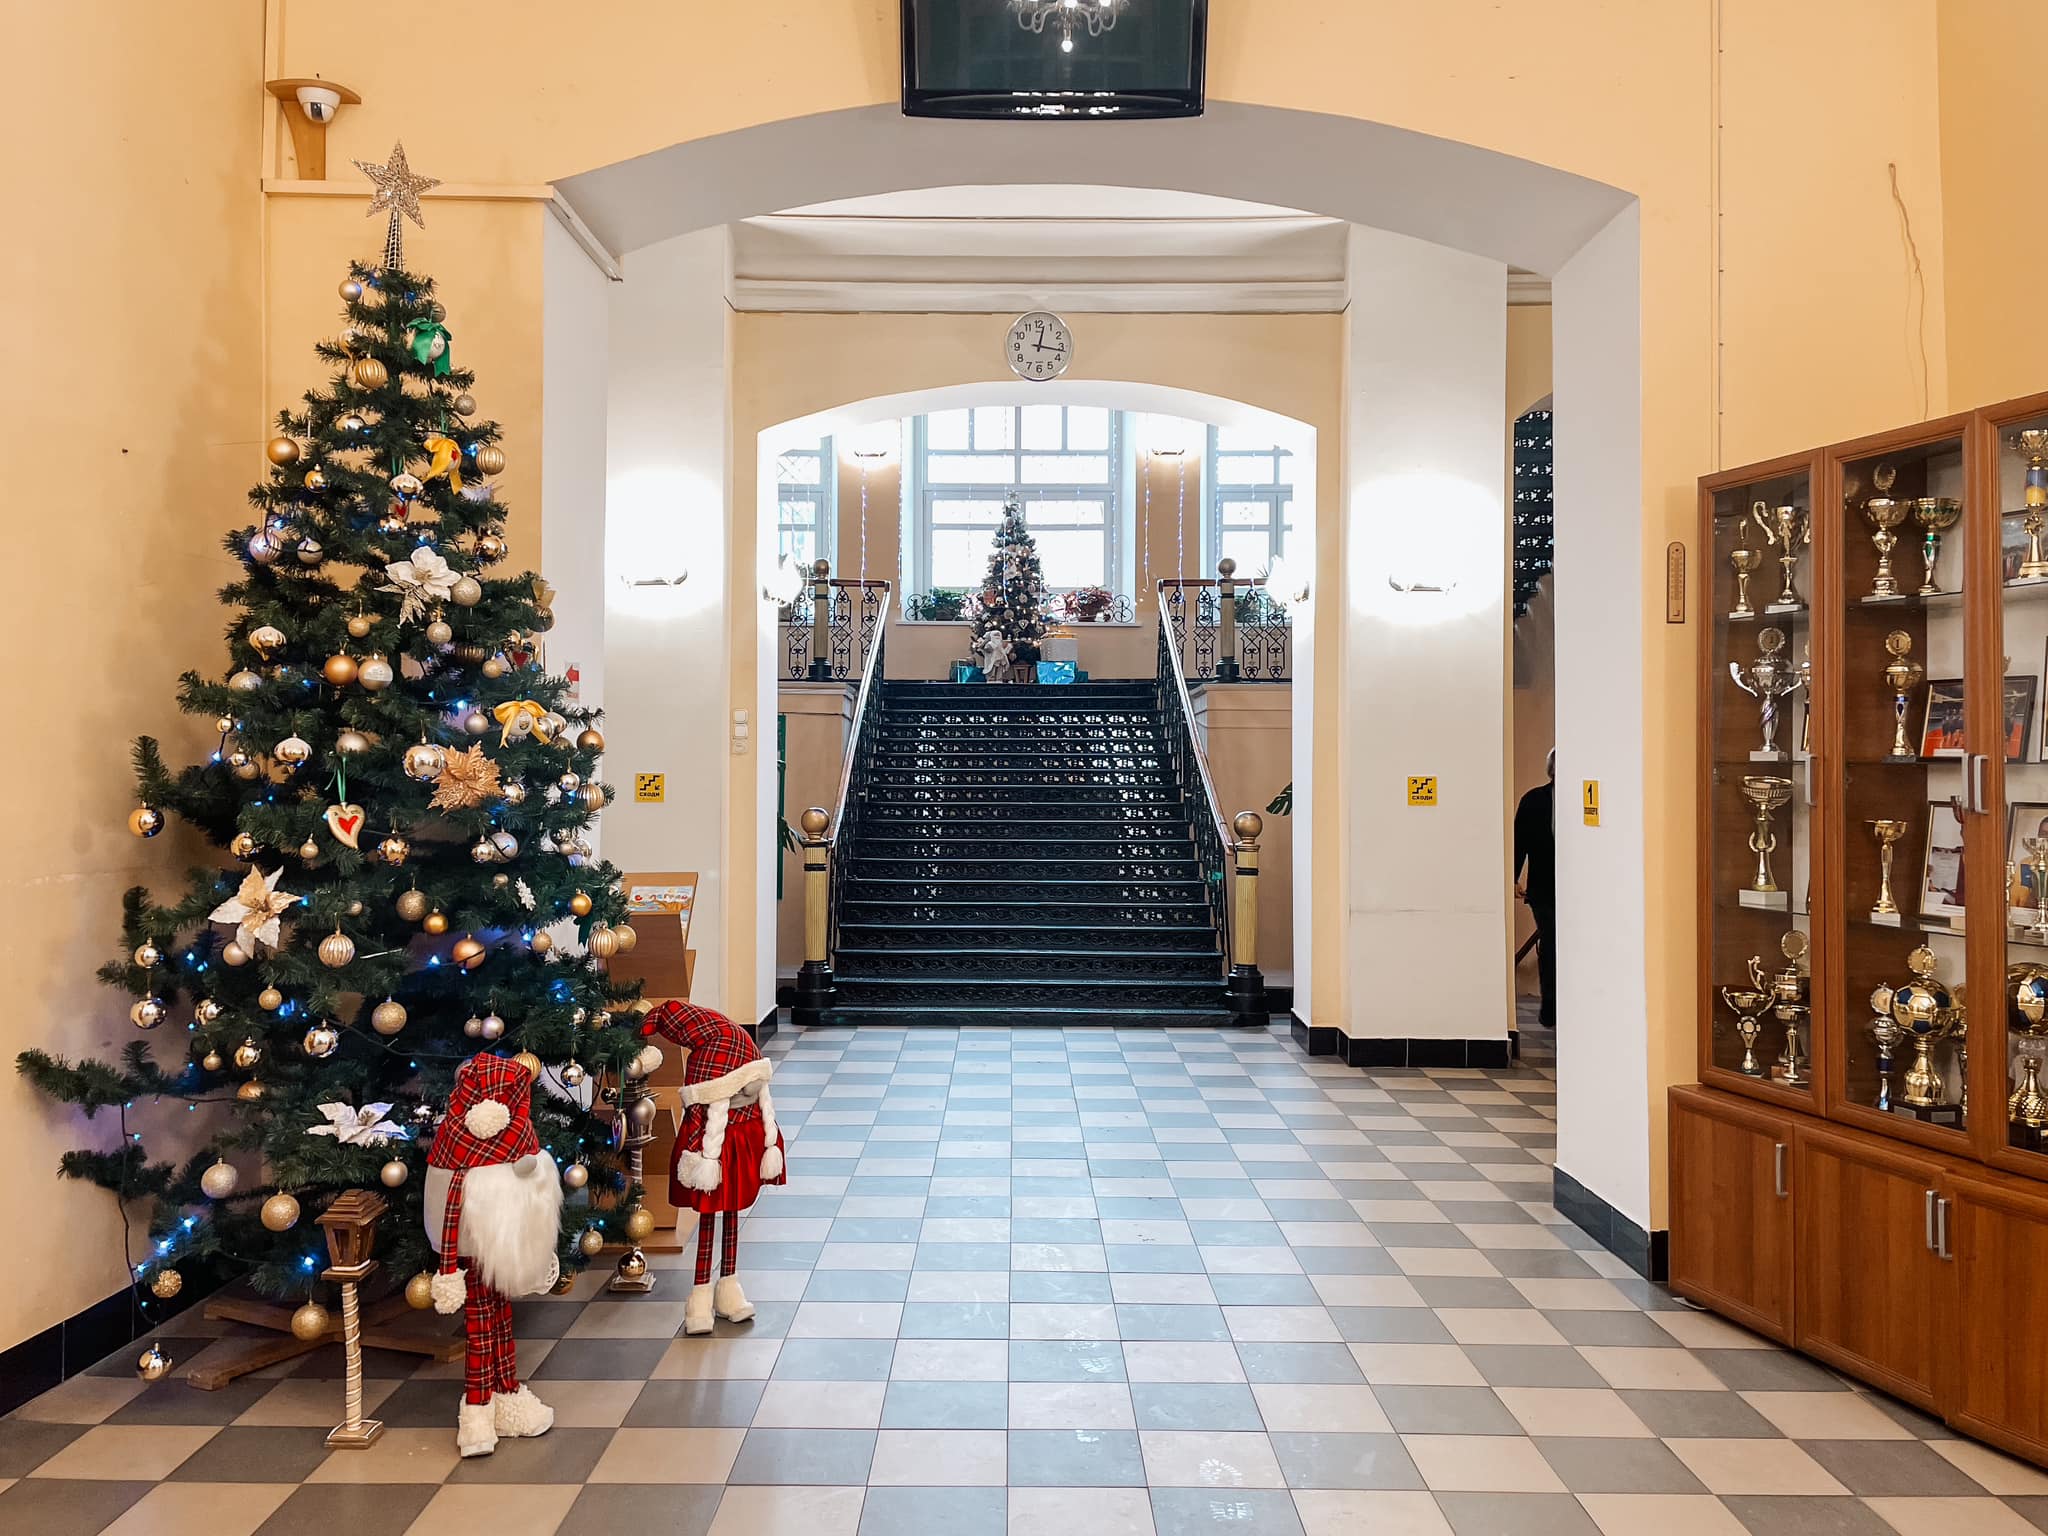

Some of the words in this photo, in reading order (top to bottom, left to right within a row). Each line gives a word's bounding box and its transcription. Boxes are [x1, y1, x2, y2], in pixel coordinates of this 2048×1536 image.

[1025, 323, 1032, 332] 11
[1034, 320, 1043, 328] 12
[1016, 331, 1025, 340] 10
[1055, 331, 1062, 340] 2
[1014, 343, 1020, 351] 9
[1058, 342, 1064, 351] 3
[1017, 354, 1024, 362] 8
[1054, 353, 1061, 361] 4
[1026, 362, 1032, 370] 7
[1036, 365, 1042, 373] 6
[1047, 361, 1053, 370] 5
[1587, 784, 1593, 804] 1
